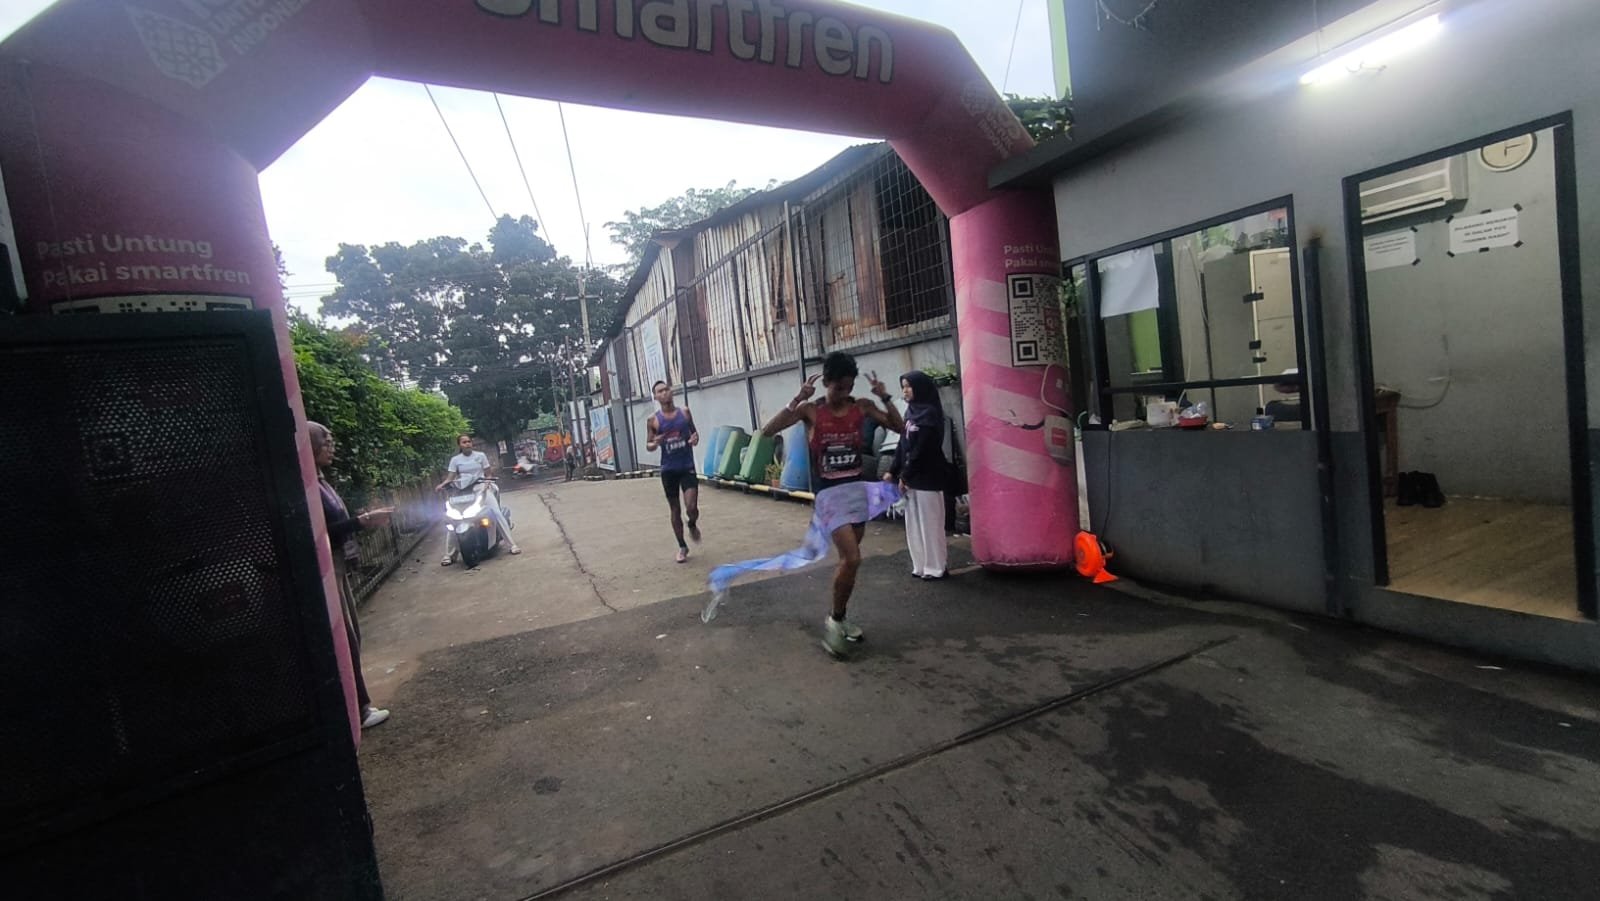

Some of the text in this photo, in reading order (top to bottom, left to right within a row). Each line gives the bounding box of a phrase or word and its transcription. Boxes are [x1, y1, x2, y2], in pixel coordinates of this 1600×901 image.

[474, 0, 894, 82] artfren
[36, 233, 214, 260] Pasti Untung
[1003, 242, 1034, 255] Pasti
[43, 261, 251, 288] Pakai smartfren
[1004, 256, 1037, 269] Pakai
